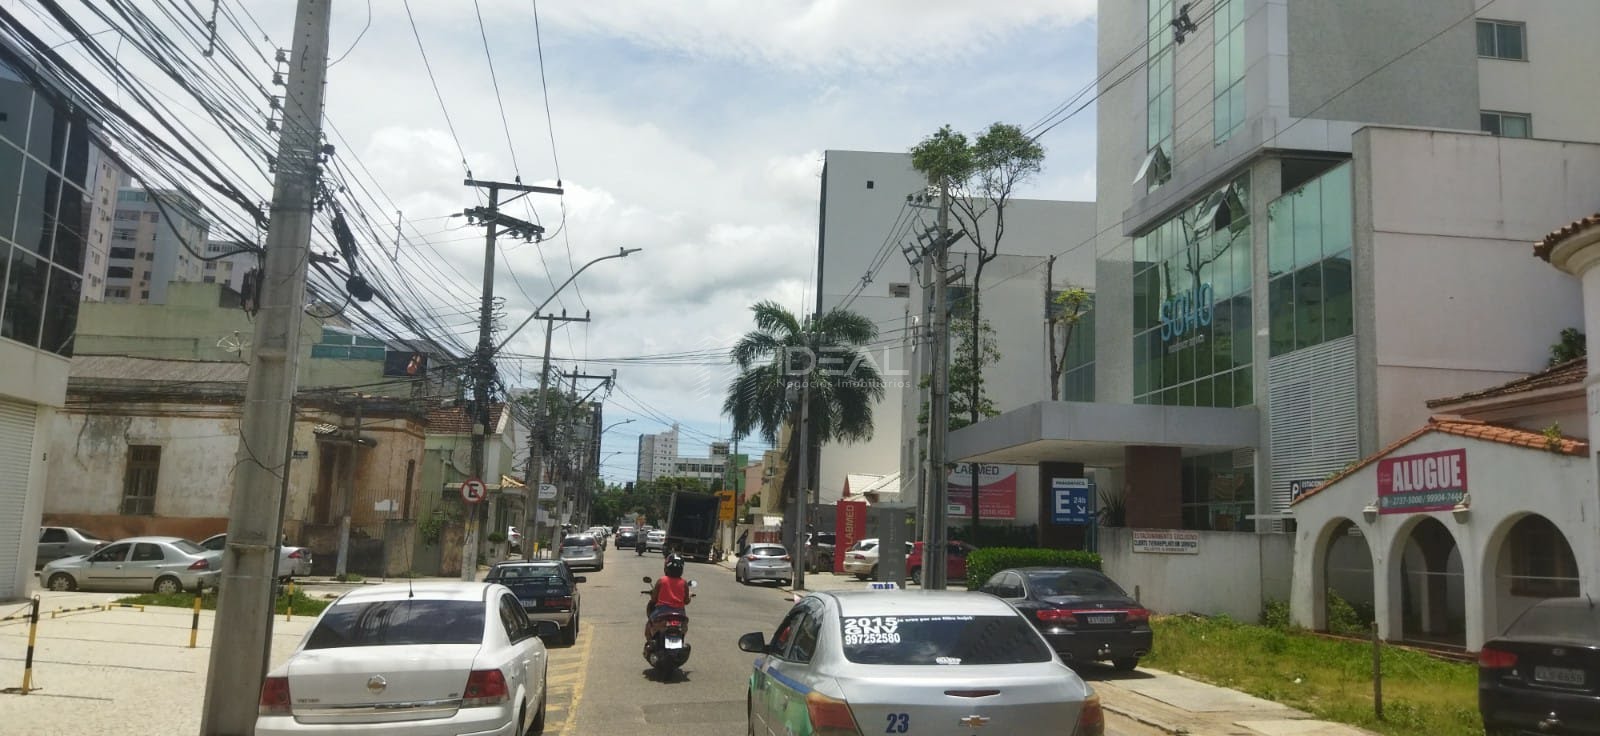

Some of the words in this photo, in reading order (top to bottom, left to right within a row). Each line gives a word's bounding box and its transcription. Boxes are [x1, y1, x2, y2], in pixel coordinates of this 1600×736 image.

[1161, 282, 1213, 341] SOHO
[1392, 455, 1462, 492] ALUGUE
[1055, 490, 1071, 514] E
[845, 505, 855, 545] LABMED
[844, 617, 898, 628] 2015
[844, 626, 899, 635] GNV
[845, 632, 901, 645] 997252580
[886, 713, 910, 733] 23
